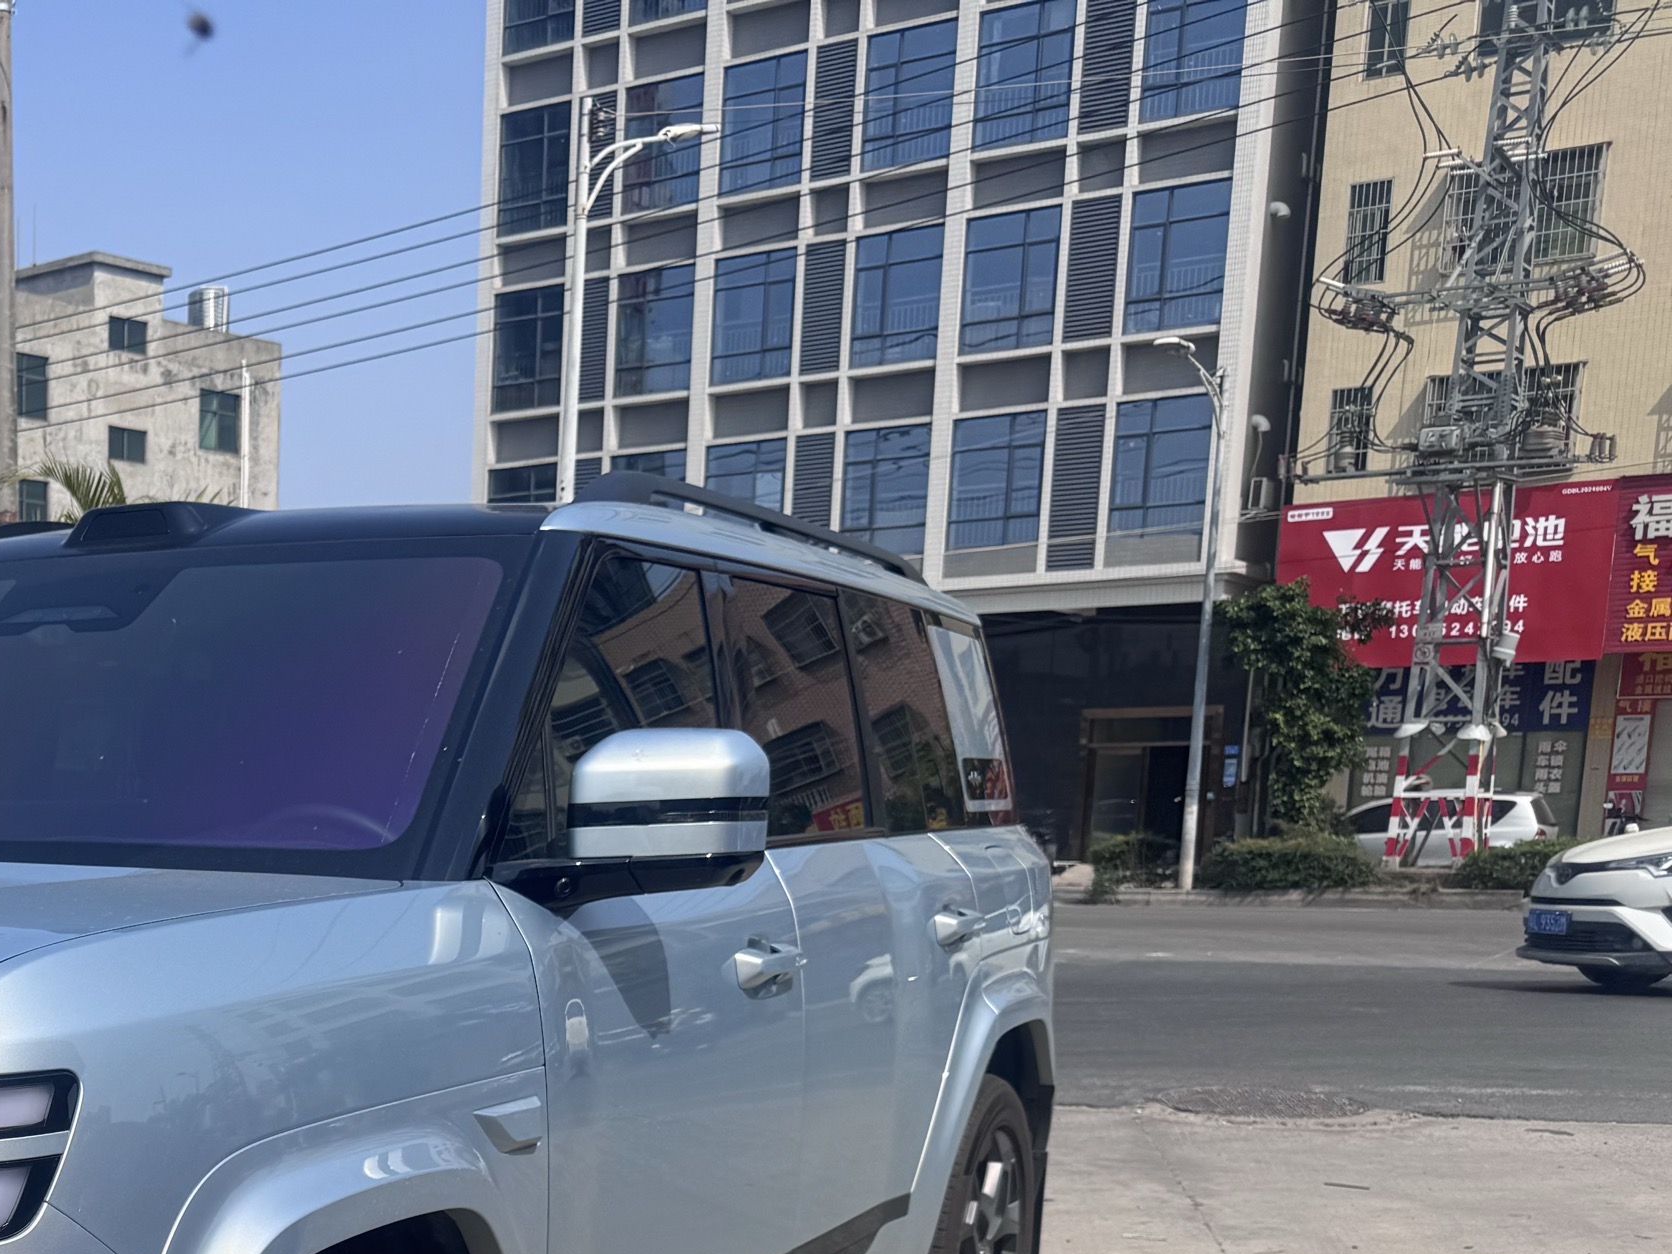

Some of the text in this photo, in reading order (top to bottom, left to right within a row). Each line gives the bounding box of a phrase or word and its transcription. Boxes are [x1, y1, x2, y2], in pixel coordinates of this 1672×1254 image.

[1513, 550, 1563, 565] 放心跑
[1620, 622, 1672, 643] 液压
